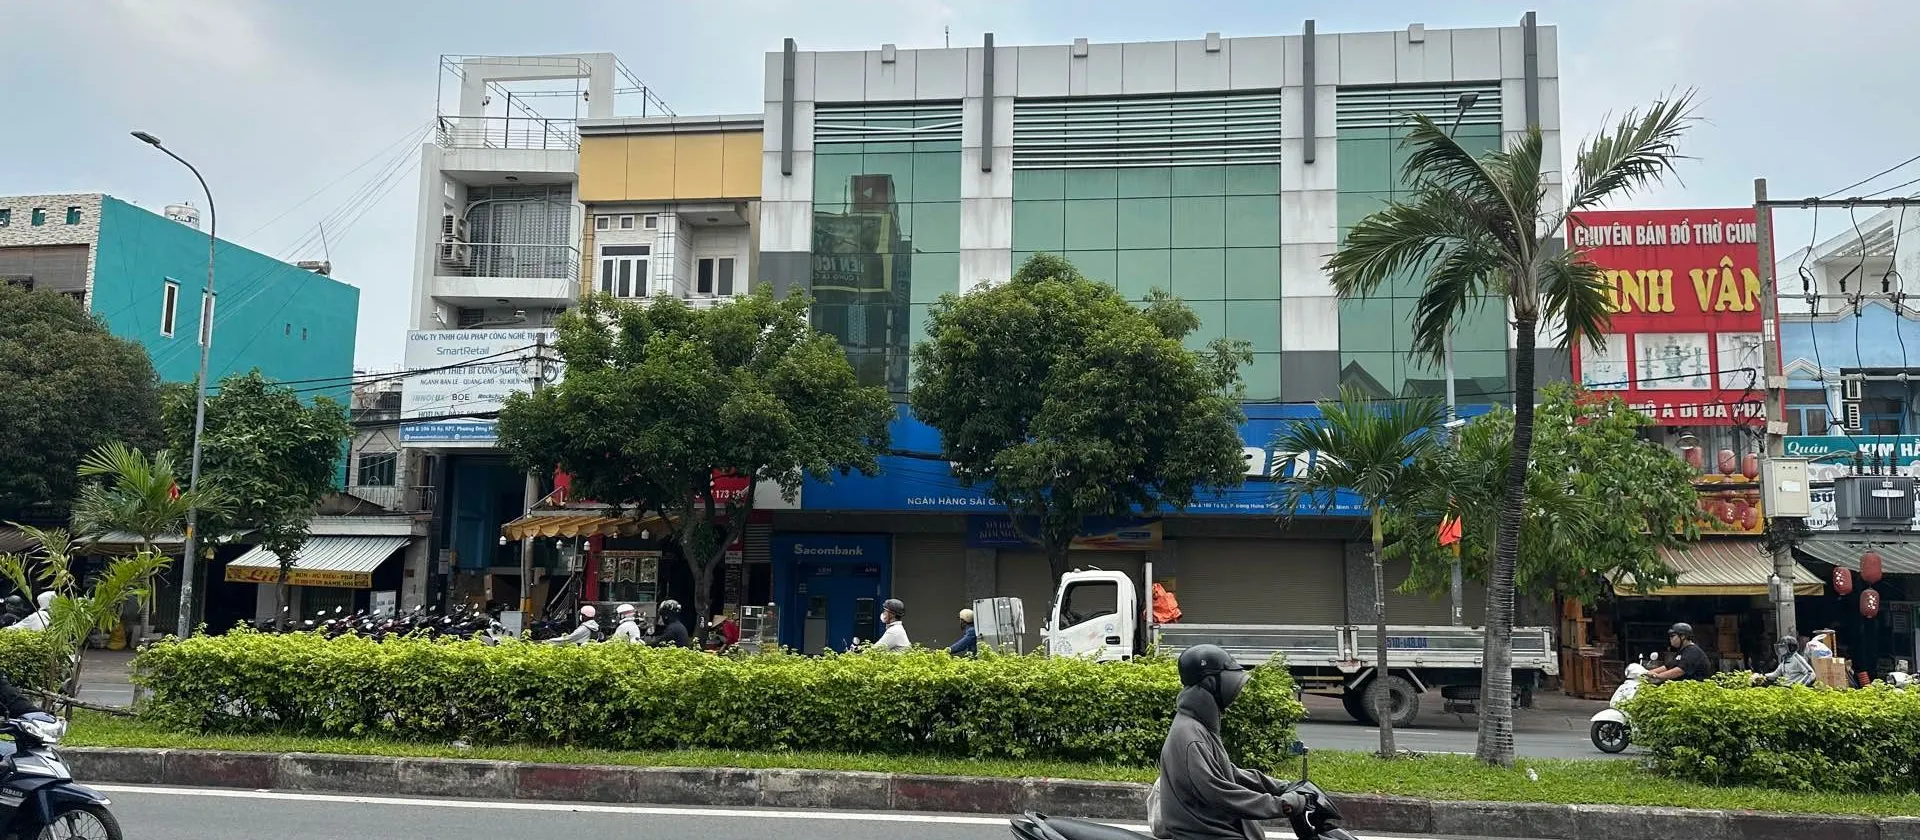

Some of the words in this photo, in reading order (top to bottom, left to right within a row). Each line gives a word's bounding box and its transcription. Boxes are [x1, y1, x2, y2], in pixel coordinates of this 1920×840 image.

[1574, 222, 1632, 246] CHUYÊN
[1635, 221, 1666, 245] BÁN
[1670, 218, 1691, 245] ĐỒ
[1693, 218, 1722, 244] THỜ
[1595, 269, 1675, 312] INH
[410, 332, 429, 341] CÔNG
[430, 333, 437, 341] TY
[438, 333, 455, 341] TNHH
[488, 331, 507, 340] CÔNG
[436, 346, 490, 356] SmartRetail
[452, 393, 470, 402] BOE
[1662, 403, 1674, 418] A
[1680, 403, 1698, 418] DI
[1703, 400, 1727, 418] ĐÀ
[1787, 441, 1829, 457] Quán
[1859, 443, 1895, 457] KIM
[907, 495, 936, 505] NGÂN
[938, 494, 967, 506] HÀNG
[969, 494, 986, 506] SÀI
[793, 543, 864, 557] Sacombank
